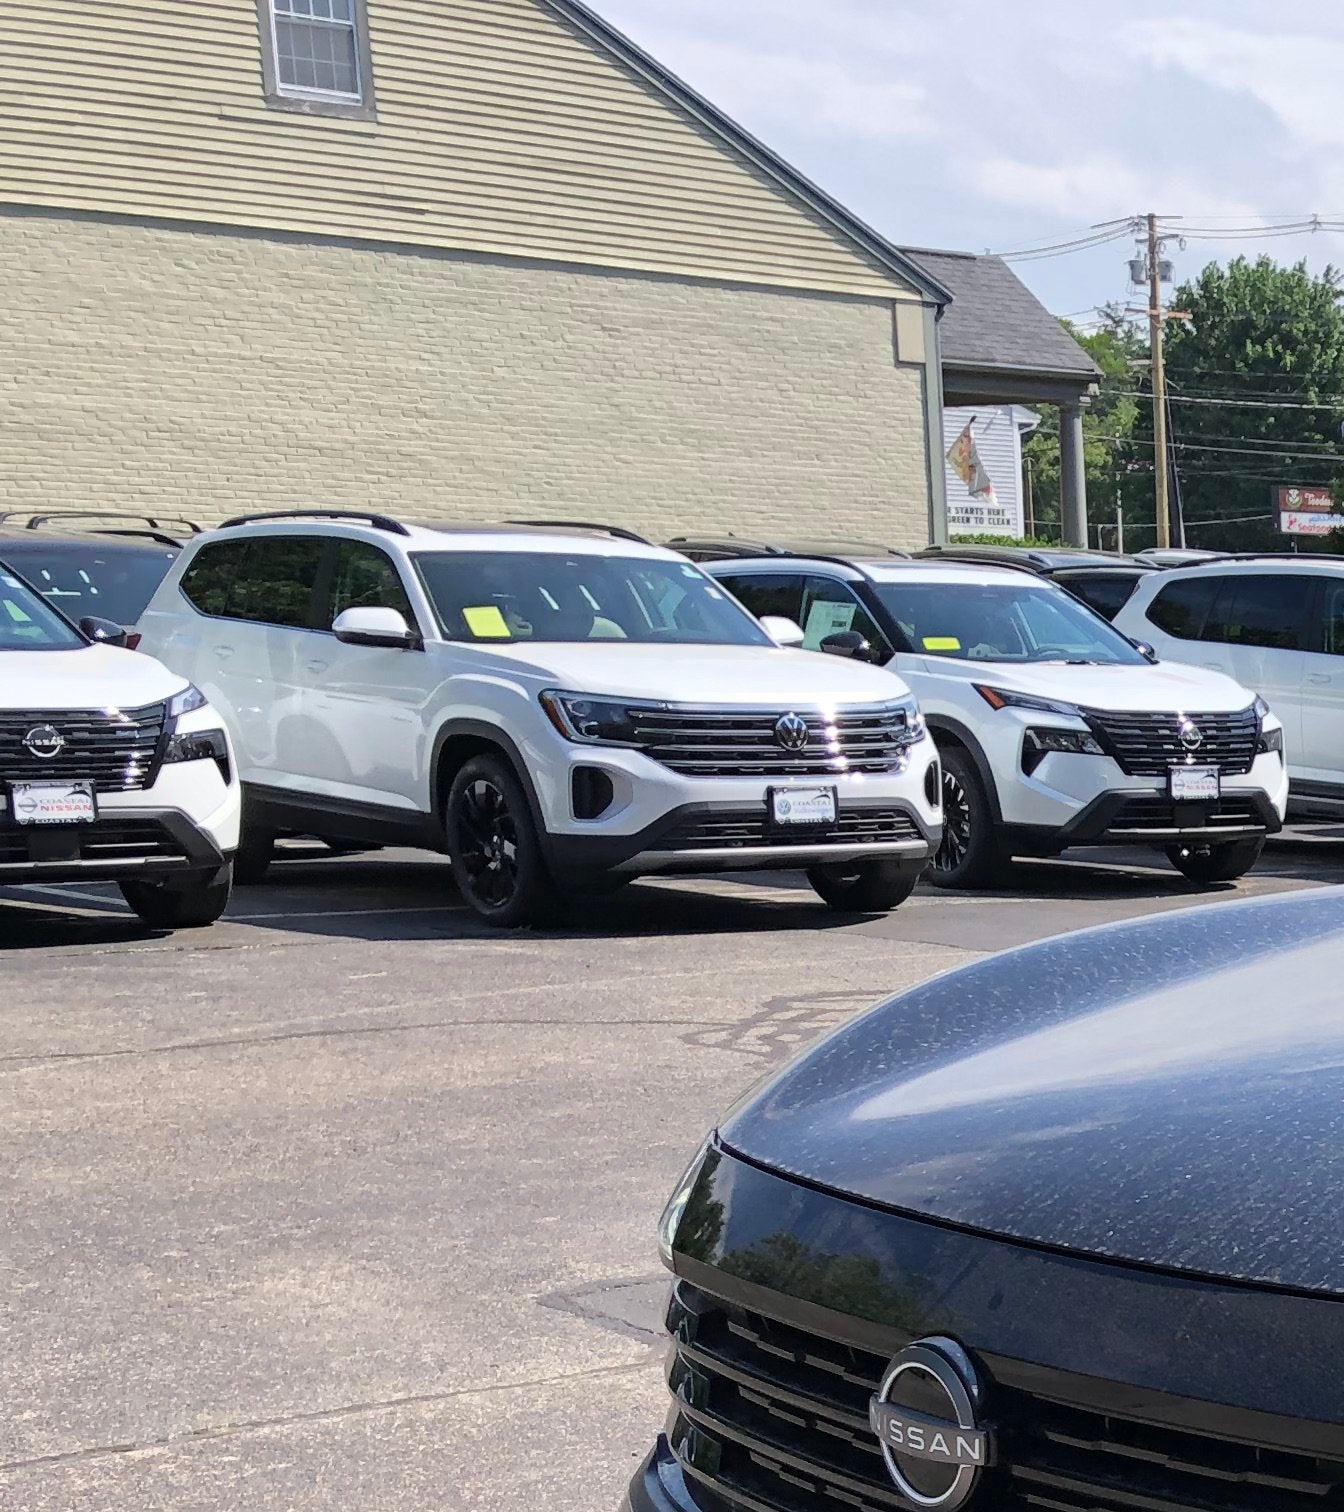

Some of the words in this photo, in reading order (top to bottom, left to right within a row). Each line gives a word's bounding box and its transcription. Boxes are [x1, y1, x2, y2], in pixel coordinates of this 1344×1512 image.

[955, 507, 984, 516] STARTS
[987, 508, 1006, 517] HERE
[974, 517, 984, 525] TO
[987, 518, 1011, 526] CLEAN
[40, 804, 93, 812] NISSAN
[871, 1405, 981, 1461] NISSAN
